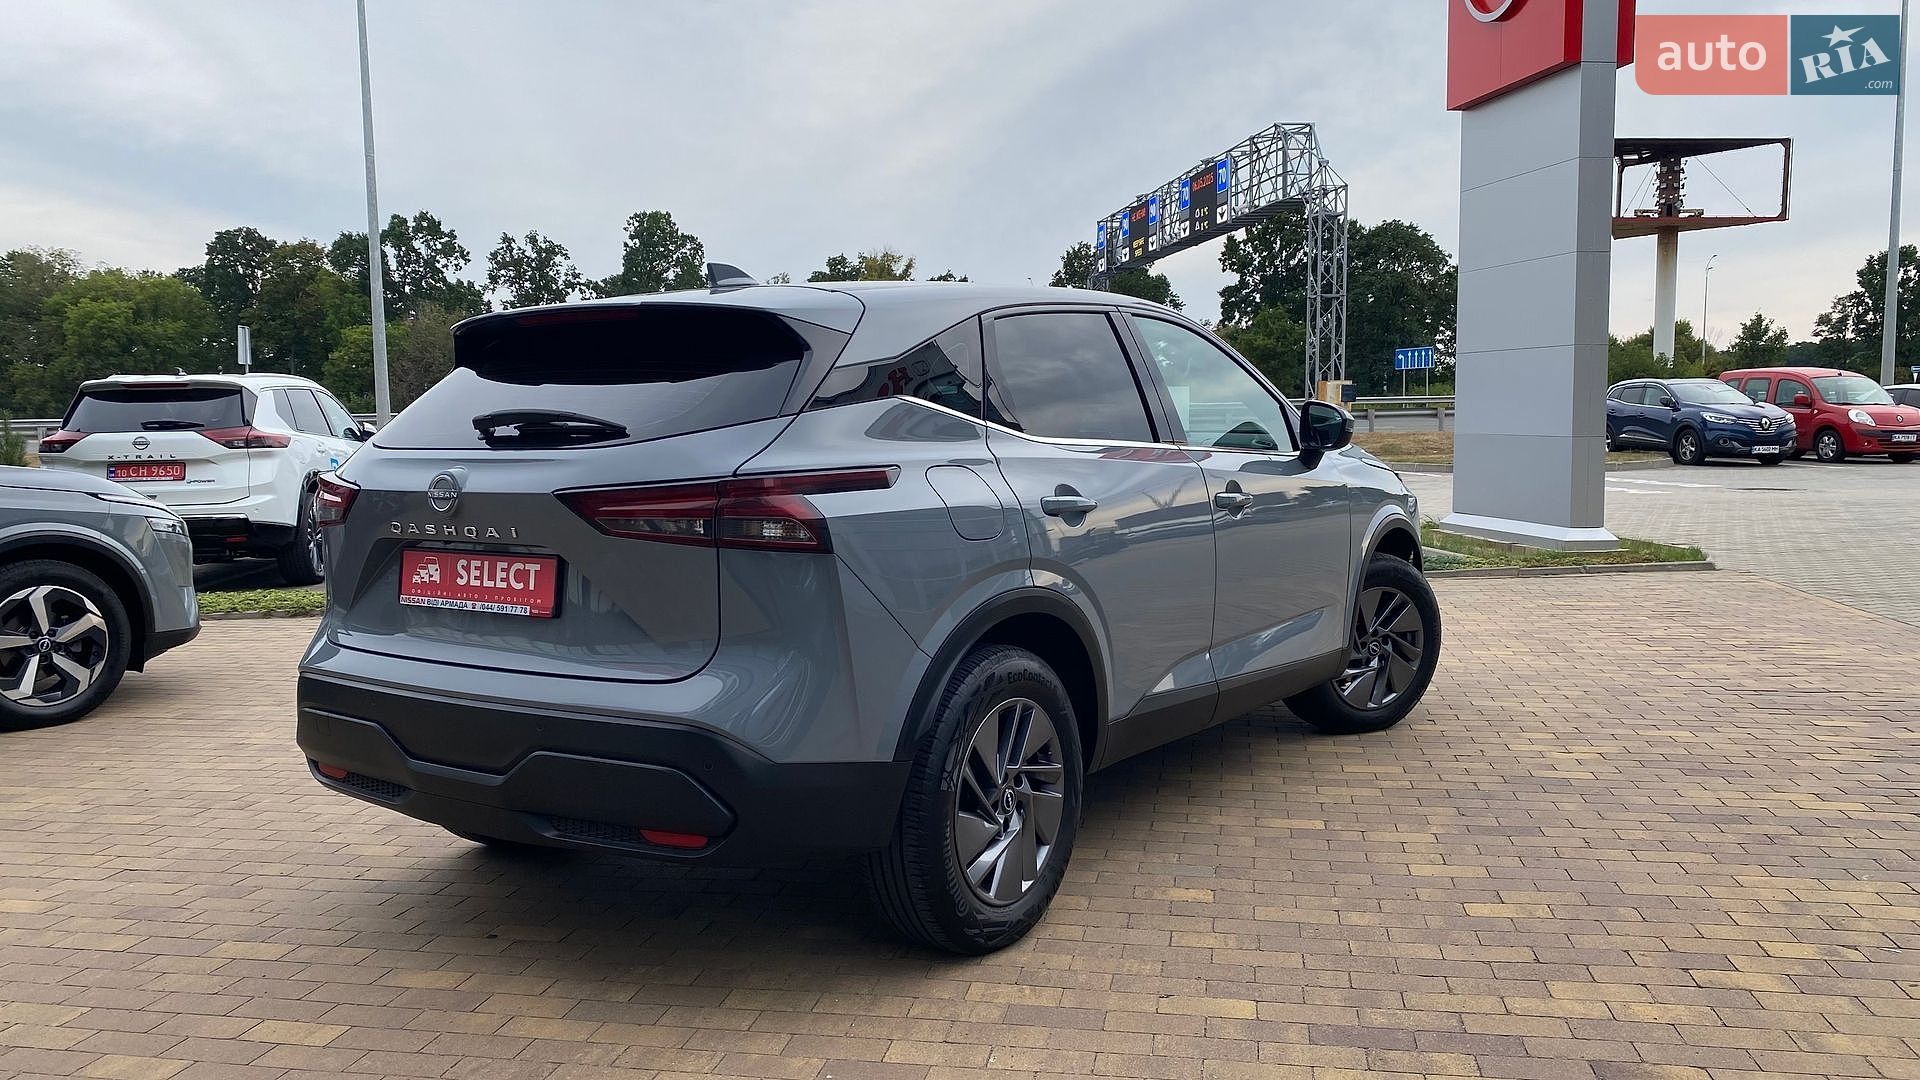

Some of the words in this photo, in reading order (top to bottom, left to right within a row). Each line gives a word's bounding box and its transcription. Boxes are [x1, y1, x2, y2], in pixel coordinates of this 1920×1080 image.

[1218, 167, 1227, 184] 70
[117, 469, 127, 477] 10
[129, 466, 147, 477] CH
[151, 465, 181, 476] 9650
[428, 490, 458, 498] NISSAN
[390, 521, 519, 539] QASHQAI
[456, 558, 541, 591] SELECT
[400, 596, 426, 605] NISSAN
[497, 604, 508, 613] 591
